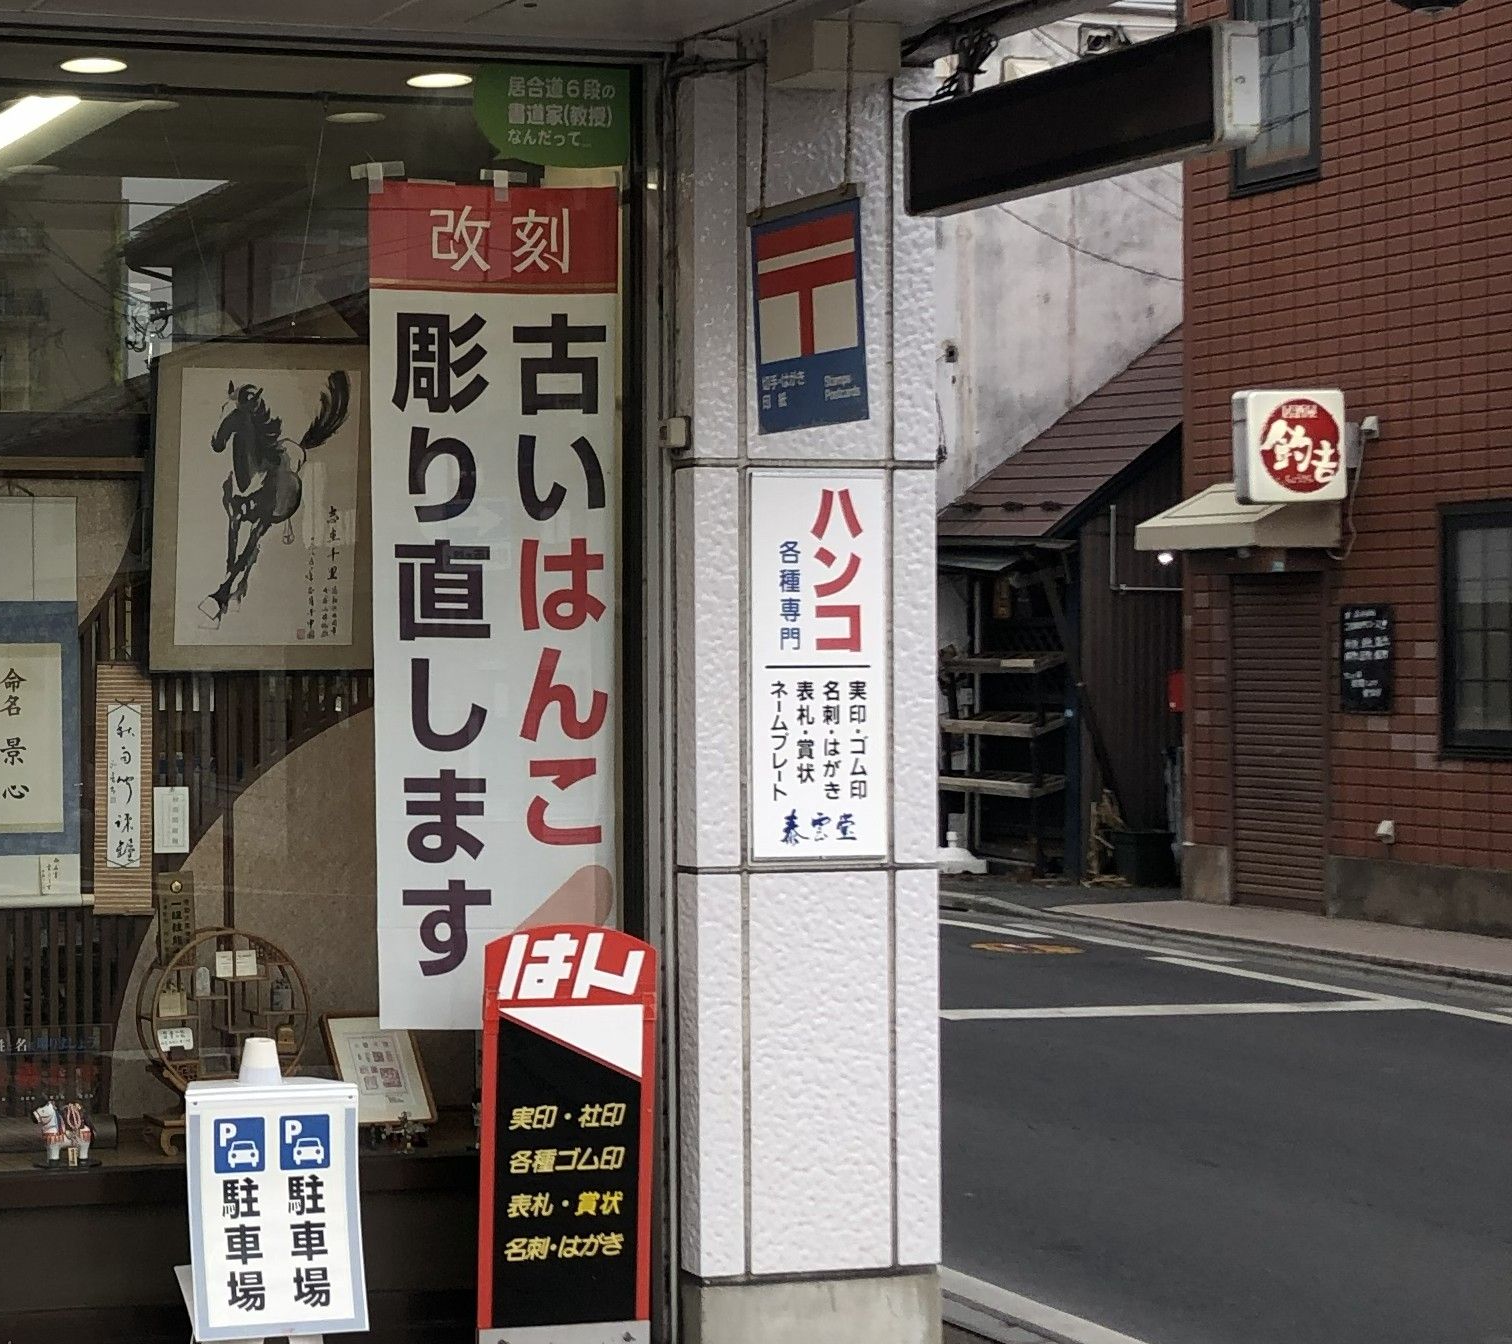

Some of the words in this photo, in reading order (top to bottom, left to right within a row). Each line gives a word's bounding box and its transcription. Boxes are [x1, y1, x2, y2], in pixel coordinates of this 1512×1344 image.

[429, 205, 571, 274] 改刻
[511, 312, 609, 847] 古いはんこ
[779, 540, 801, 651] 各種専門
[810, 488, 863, 653] ハンコ
[390, 311, 492, 978] 彫り直します
[770, 680, 790, 802] ネームプレート
[795, 680, 815, 784] 表札・賞状
[822, 680, 841, 800] 名刺・はがき
[848, 680, 869, 800] 実印・ゴム印
[508, 1102, 628, 1131] 実印・社印
[509, 1146, 626, 1175] 各種ゴム印
[222, 1177, 267, 1313] 駐車場
[287, 1173, 332, 1309] 駐車場
[504, 1231, 625, 1263] 名刺・はがき
[507, 1191, 624, 1219] 表札・賞状
